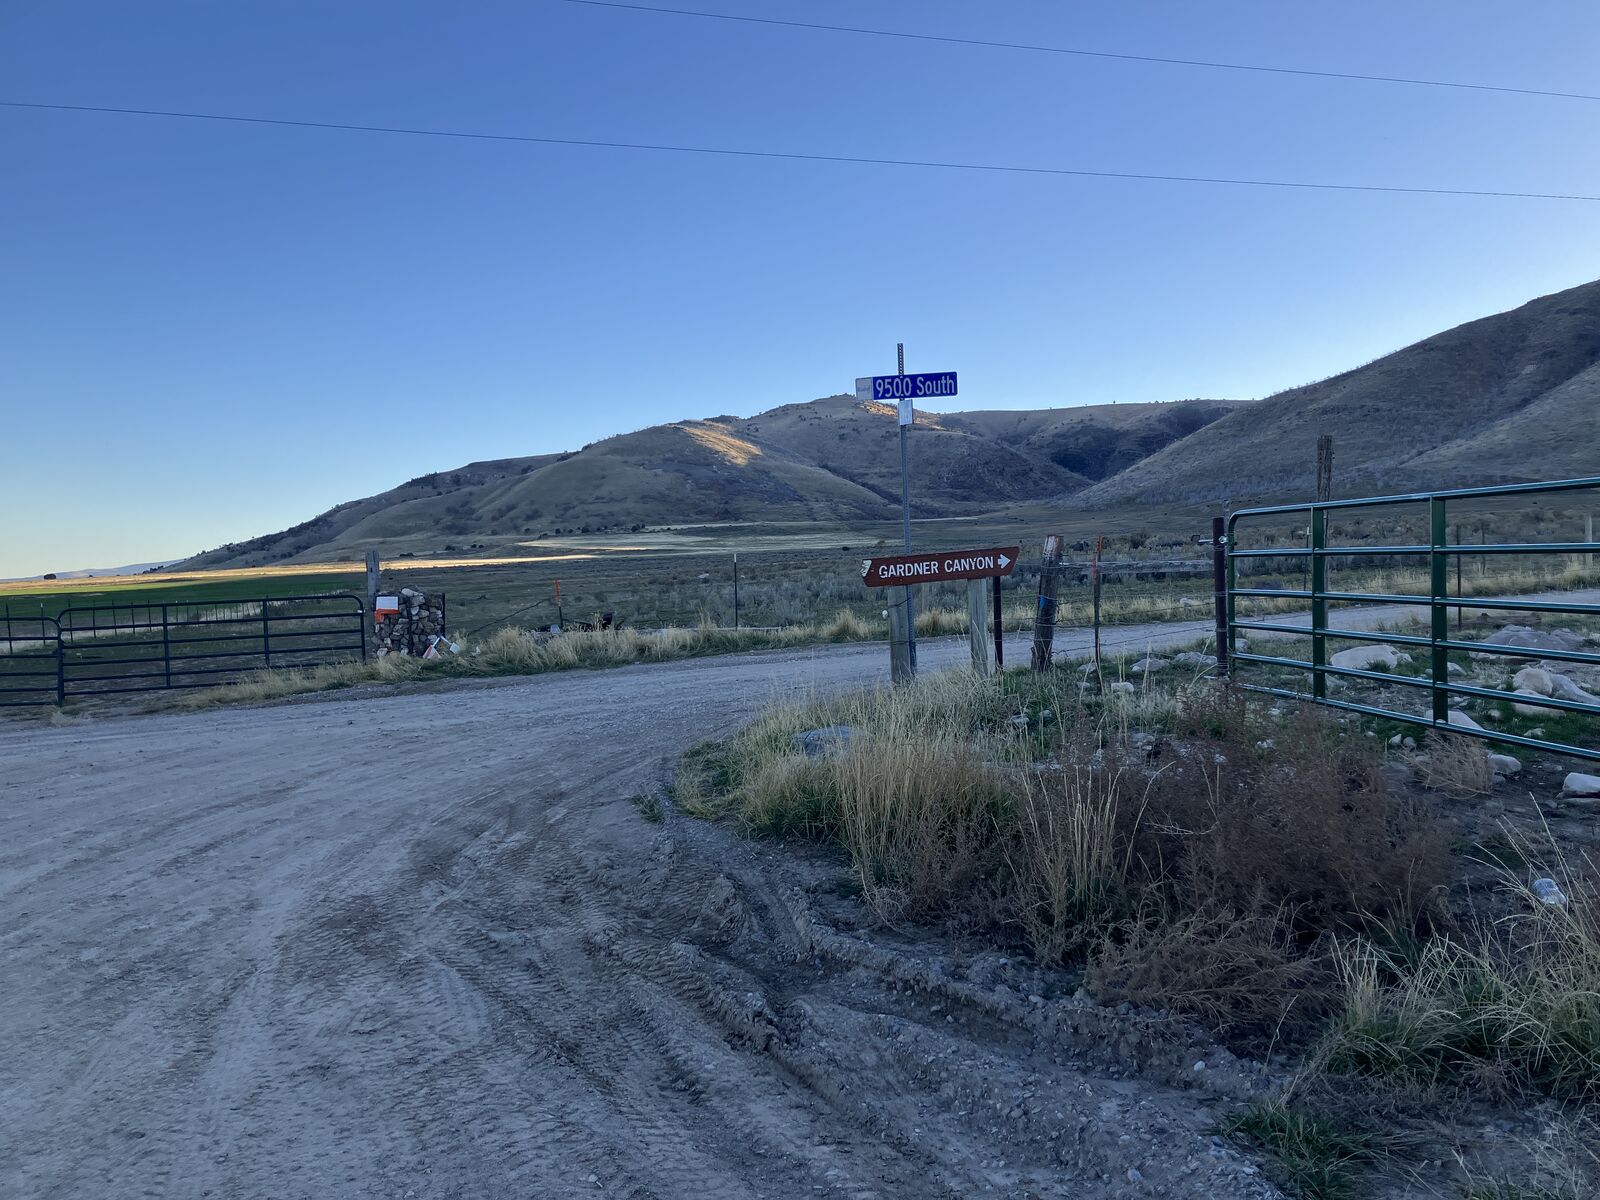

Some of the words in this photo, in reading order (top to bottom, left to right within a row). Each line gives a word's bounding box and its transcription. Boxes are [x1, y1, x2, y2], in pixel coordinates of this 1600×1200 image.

[876, 377, 912, 398] 9500
[917, 376, 955, 396] South
[879, 561, 939, 579] GARDNER
[944, 556, 994, 573] CANYON
